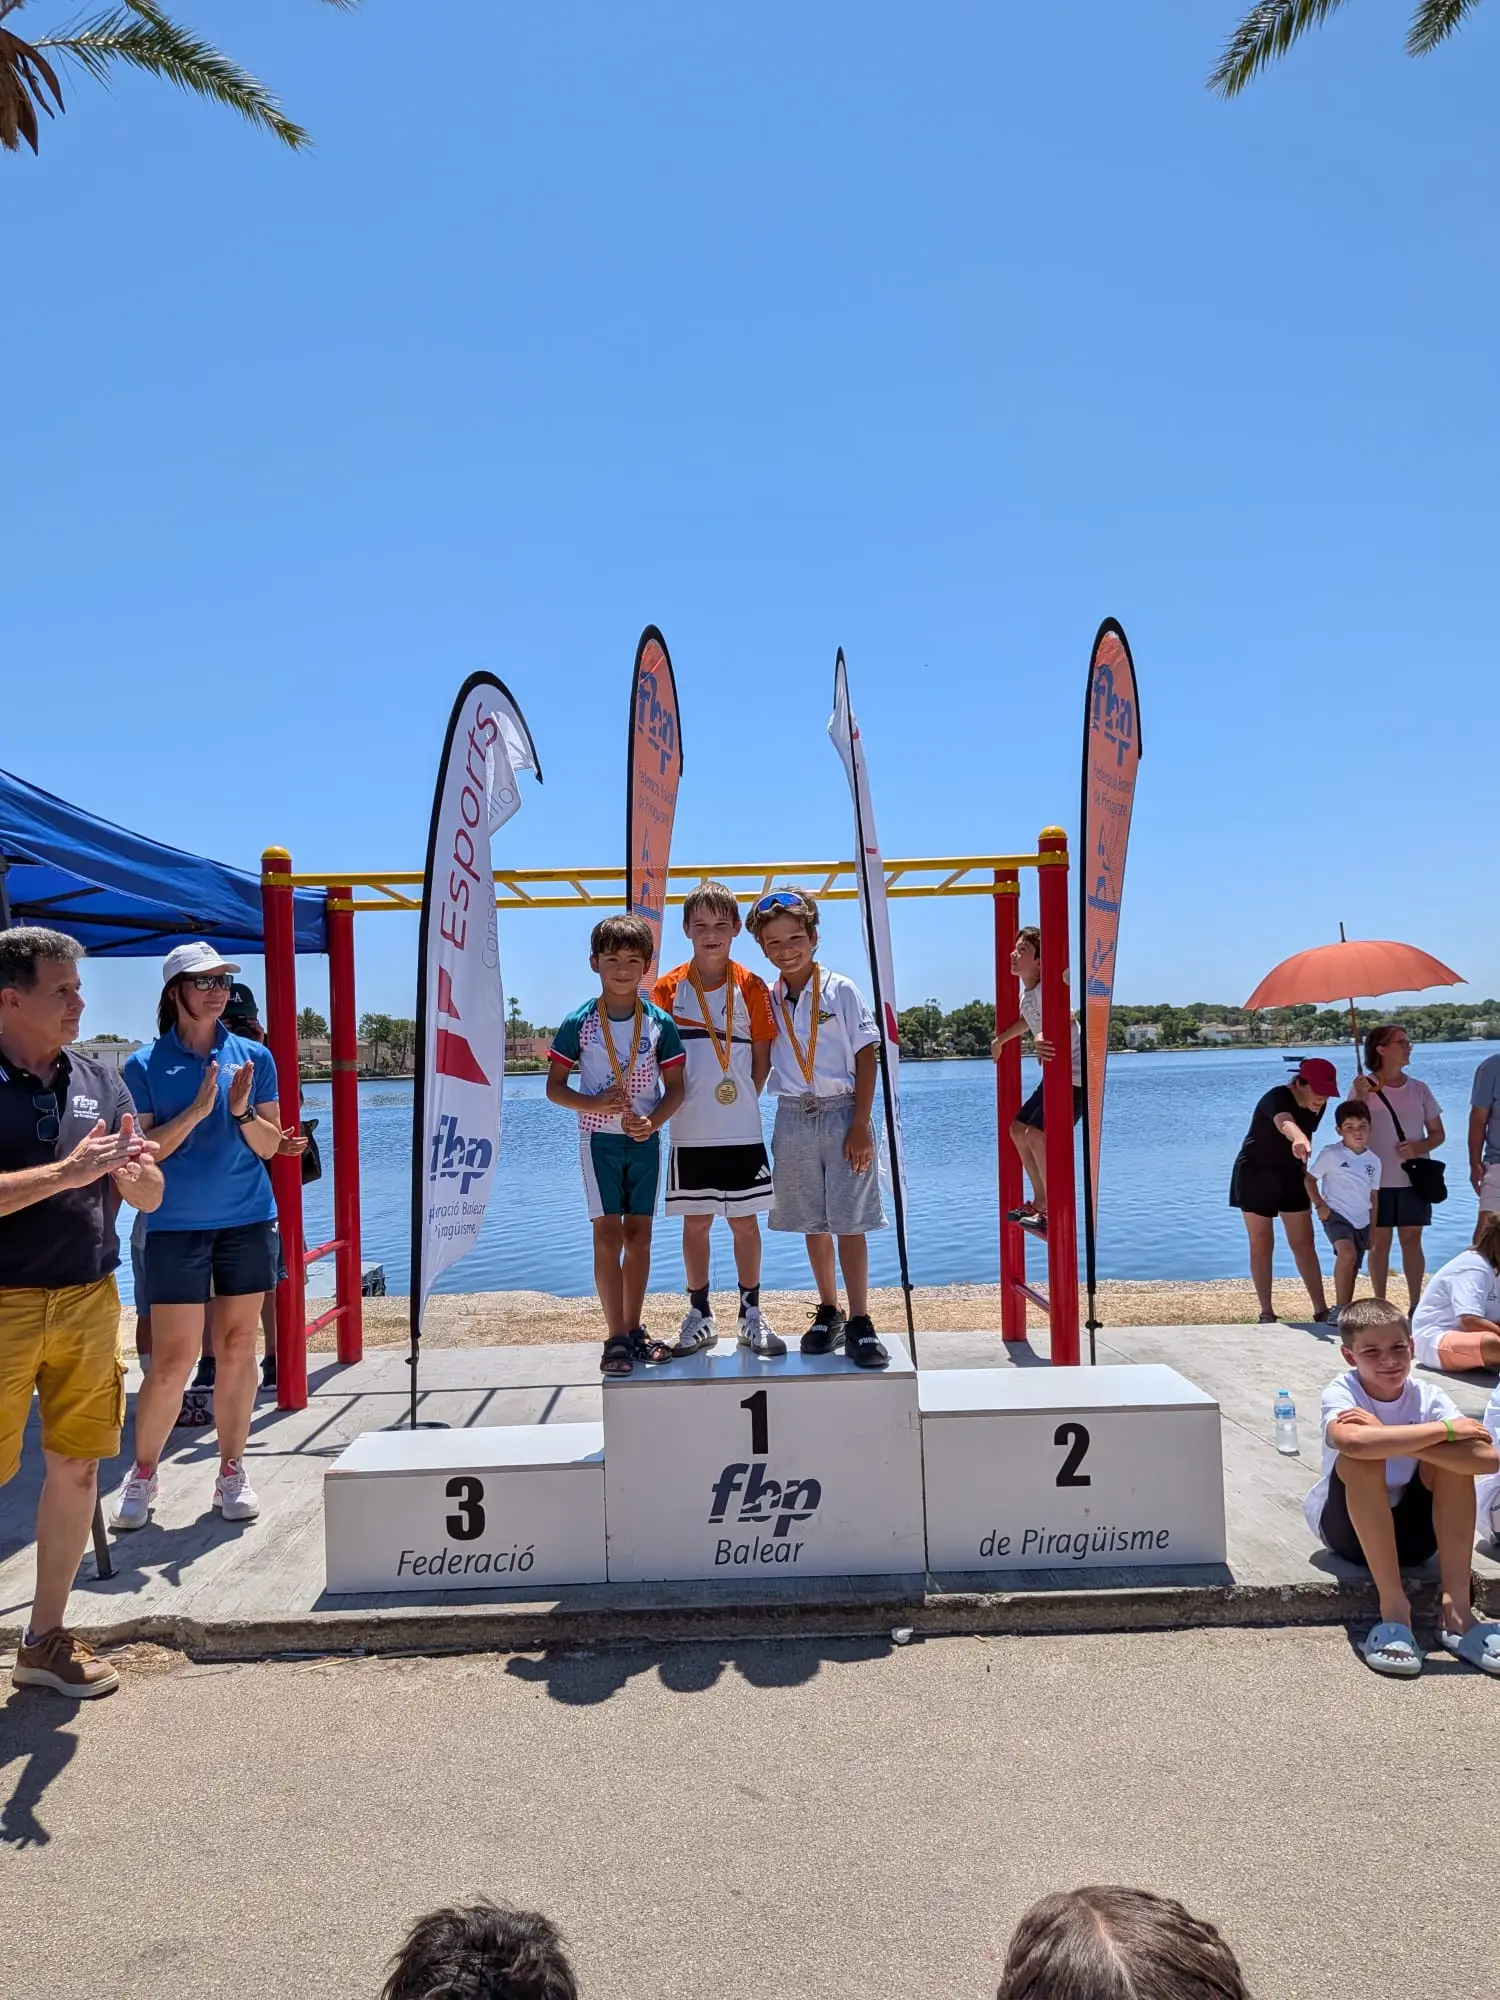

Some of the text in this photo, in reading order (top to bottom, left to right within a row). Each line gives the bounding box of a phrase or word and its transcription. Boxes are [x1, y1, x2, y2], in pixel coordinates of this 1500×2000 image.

[440, 701, 498, 950] Esports
[740, 1390, 769, 1454] 1
[1053, 1422, 1091, 1488] 2
[445, 1476, 486, 1541] 3
[708, 1462, 822, 1538] fbp
[397, 1544, 535, 1577] Federació
[715, 1536, 804, 1566] Balear
[979, 1526, 1170, 1560] de Piragüisme
